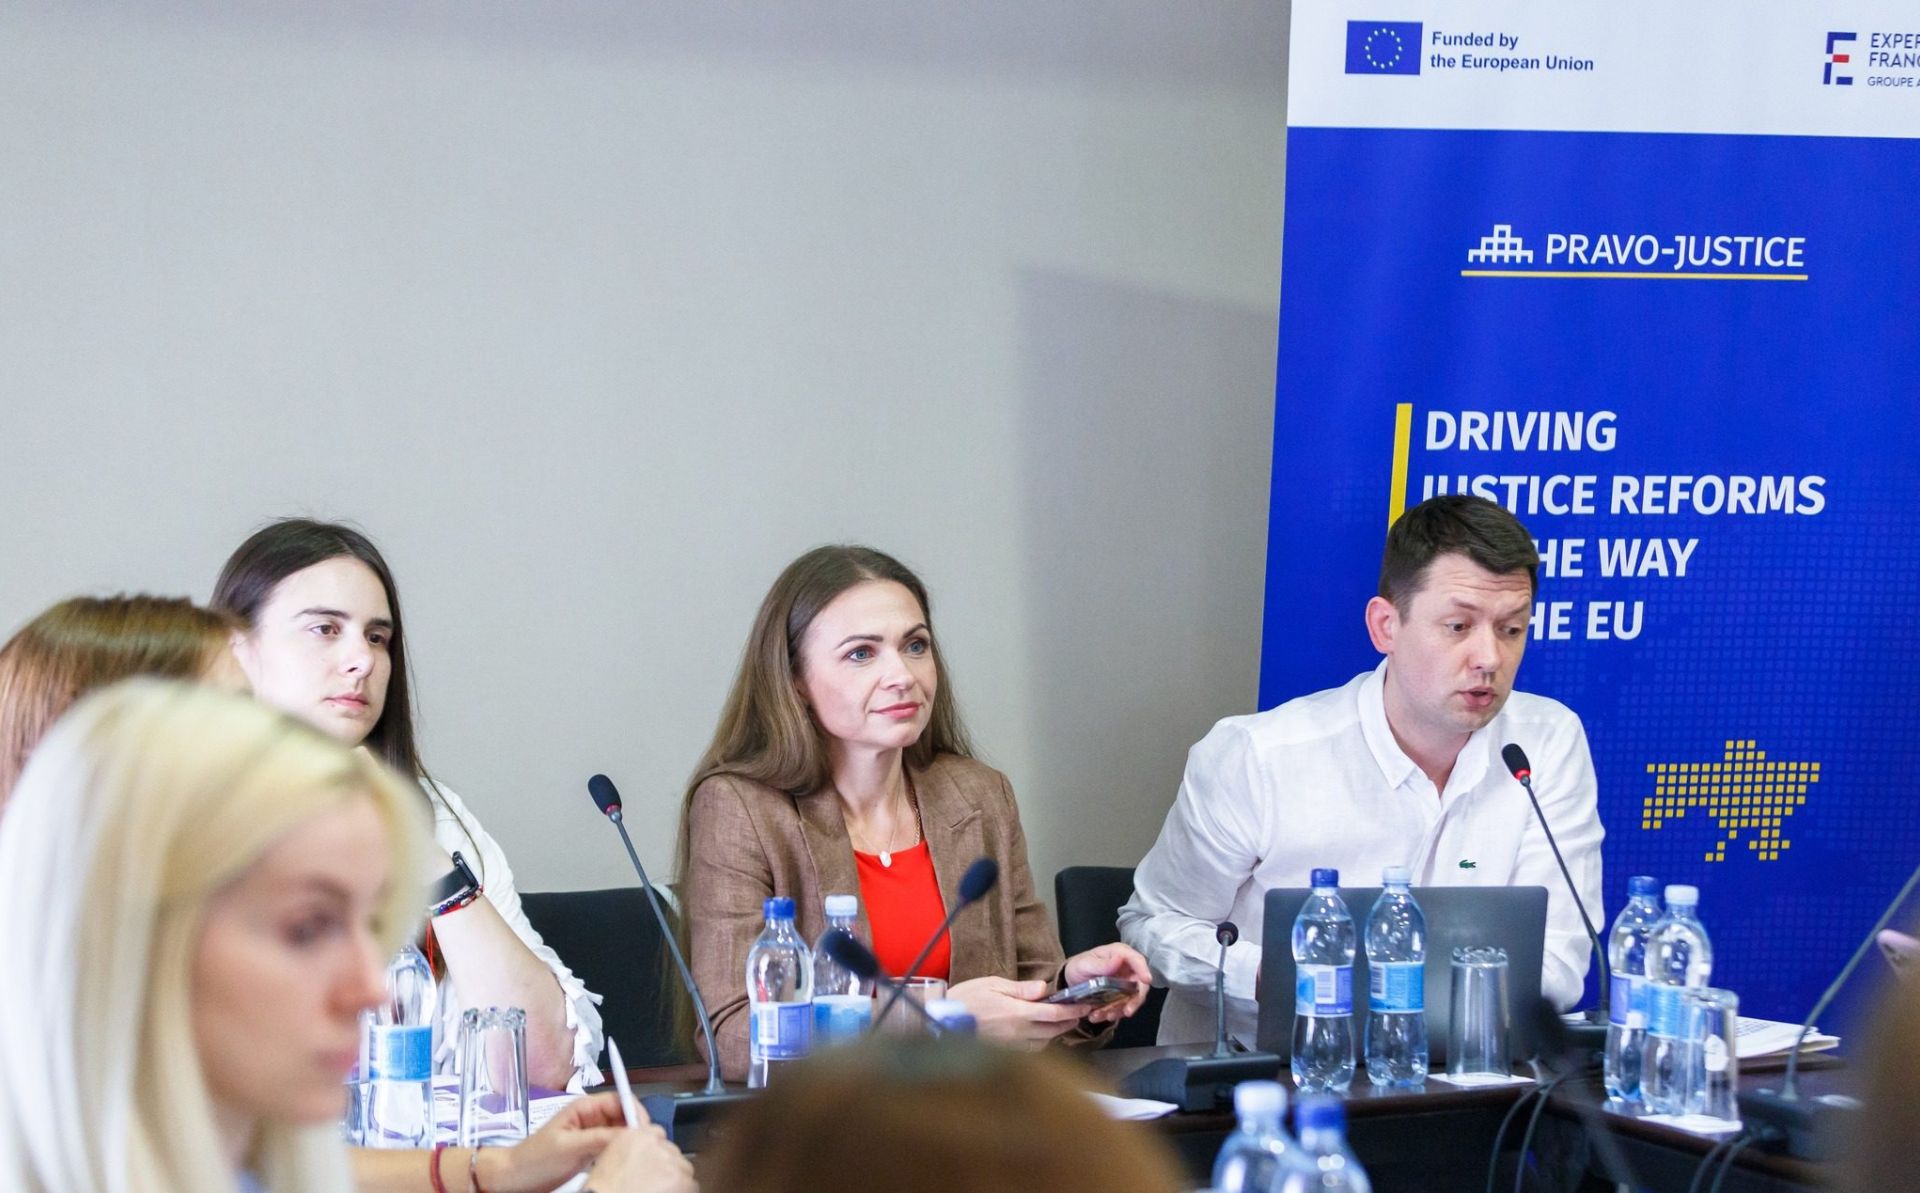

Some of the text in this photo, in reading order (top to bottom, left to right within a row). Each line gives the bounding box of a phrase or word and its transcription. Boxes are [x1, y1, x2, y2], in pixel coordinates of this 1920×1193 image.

[1432, 31, 1519, 51] Funded by
[1430, 54, 1594, 72] the European Union
[1867, 76, 1914, 88] GROUPE
[1546, 233, 1806, 270] PRAVO-JUSTICE
[1425, 410, 1617, 452] DRIVING
[1610, 474, 1826, 516] REFORMS
[1530, 538, 1699, 577] HE WAY
[1586, 601, 1644, 640] EU
